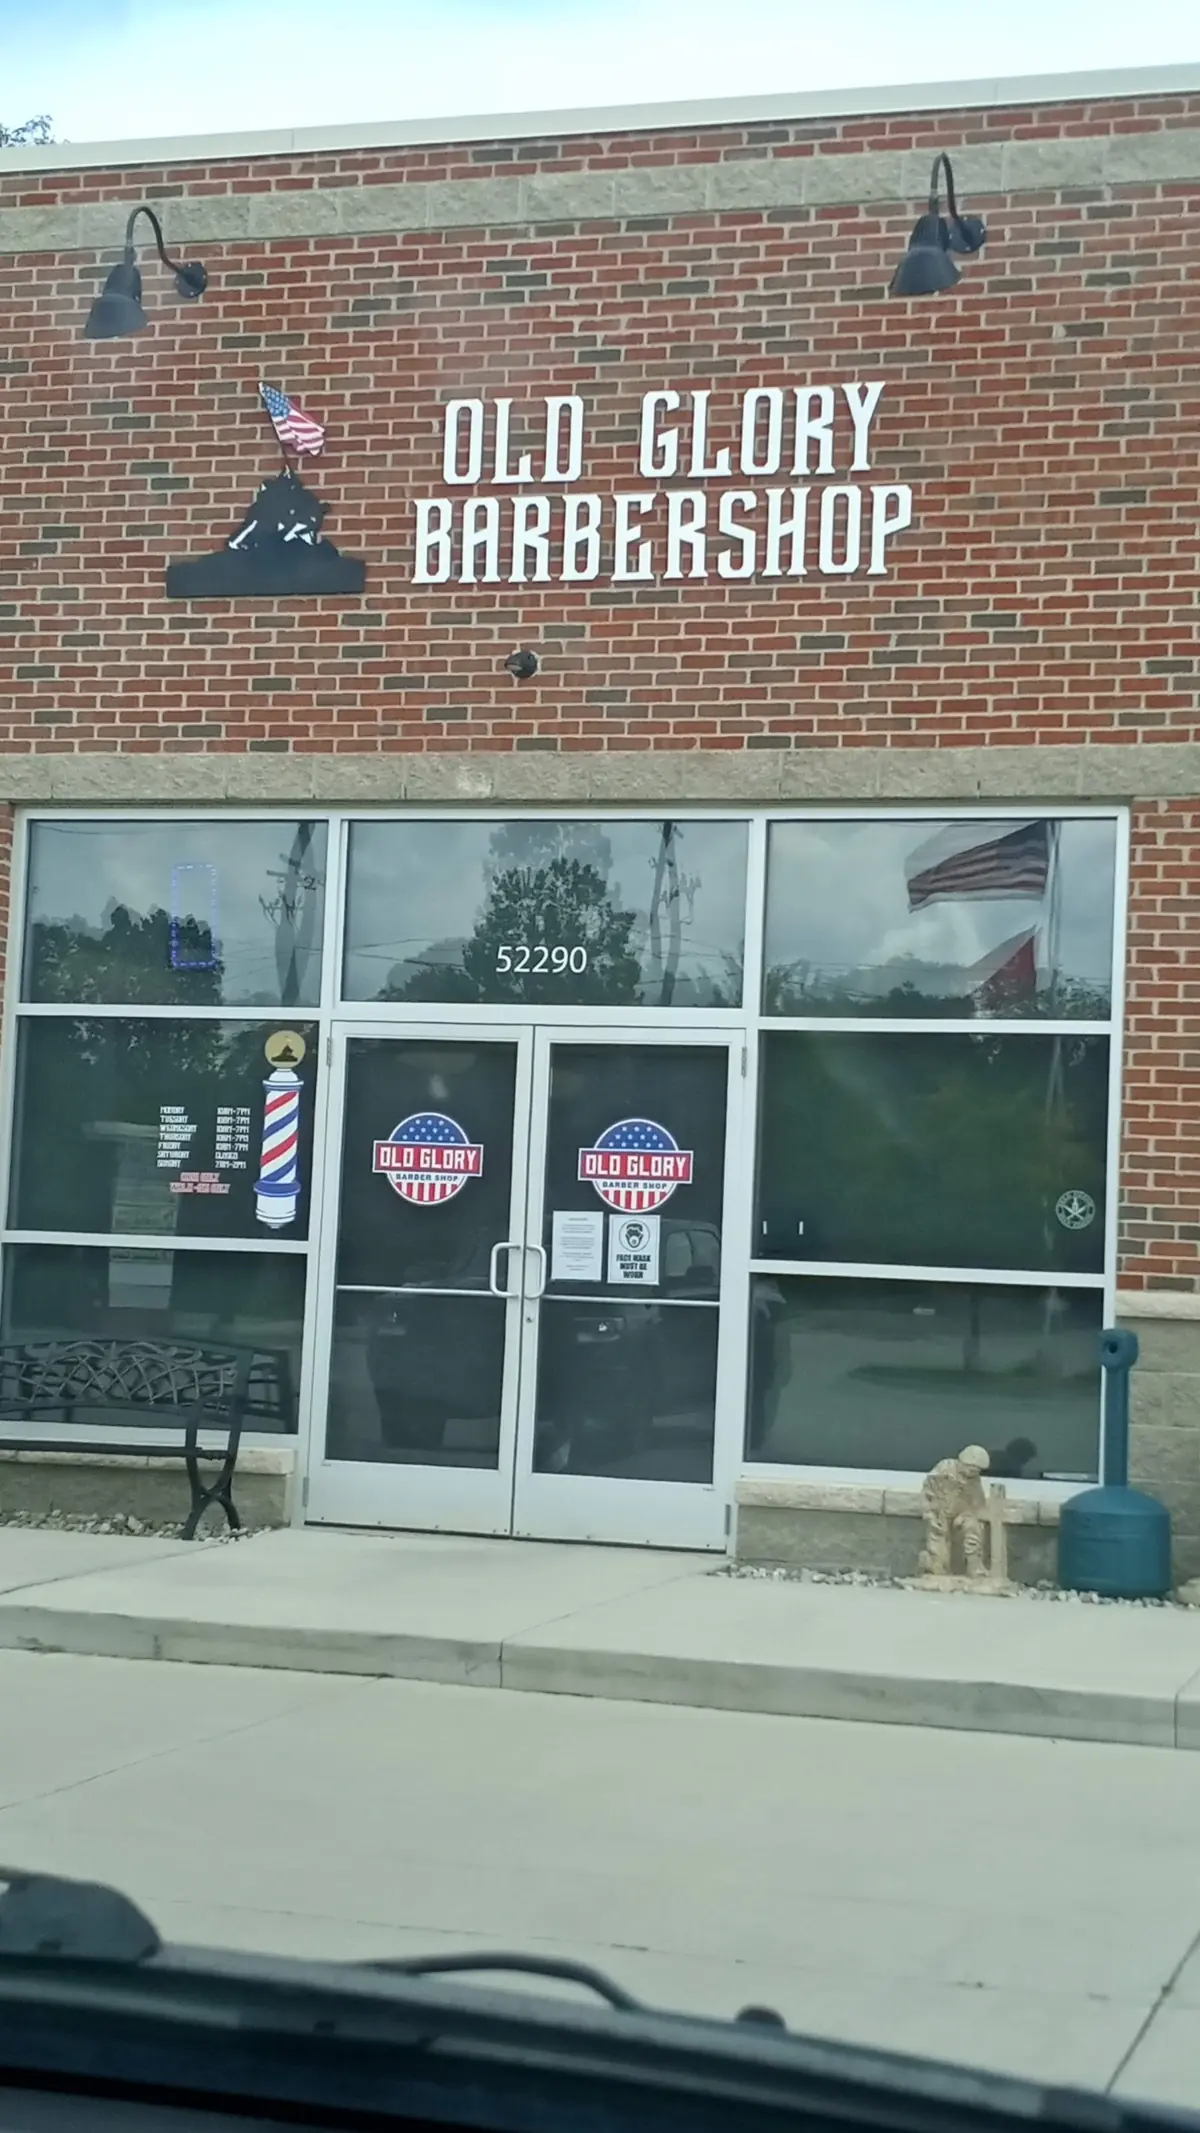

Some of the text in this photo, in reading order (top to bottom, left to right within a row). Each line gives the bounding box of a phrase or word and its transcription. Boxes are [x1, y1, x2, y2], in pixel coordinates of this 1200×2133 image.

[443, 381, 885, 484] OLD GLORY
[411, 484, 913, 584] BARBERSHOP
[496, 946, 587, 974] 52290
[160, 1115, 188, 1123] TUESDAY
[160, 1124, 197, 1132] WEDNESDAY
[380, 1146, 476, 1170] OLD GLORY
[585, 1154, 687, 1177] OLD GLORY
